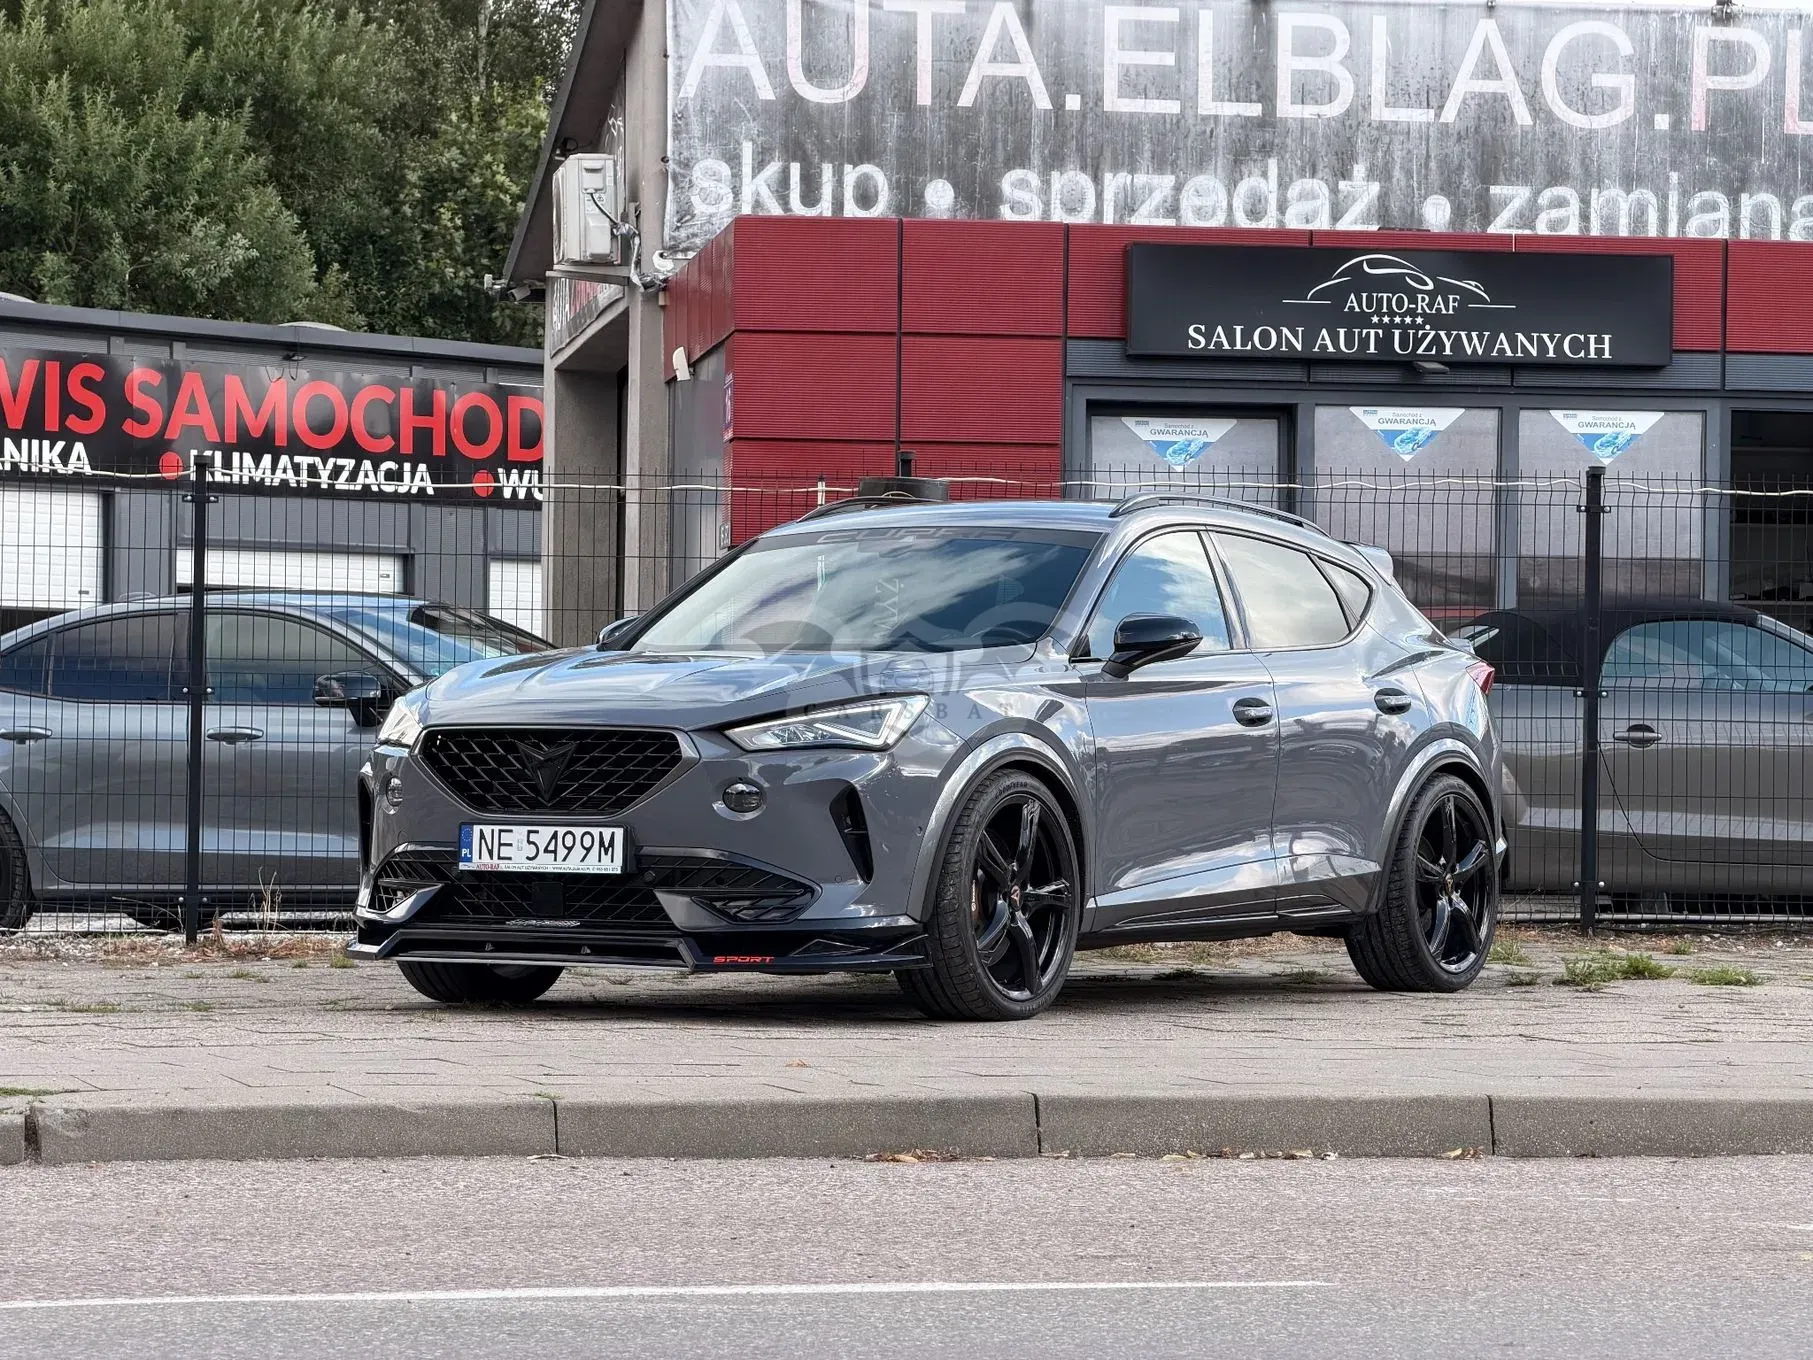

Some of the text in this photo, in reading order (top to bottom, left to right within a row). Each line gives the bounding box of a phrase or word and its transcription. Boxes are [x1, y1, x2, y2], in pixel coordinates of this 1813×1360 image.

[690, 140, 889, 217] skup
[999, 157, 1381, 232] sprzedaż
[1344, 292, 1460, 315] AUTO-RAF
[1187, 324, 1613, 359] SALON AUT UŻYWANYCH
[121, 366, 544, 462] SAMOCHOD
[1377, 417, 1437, 427] GWARANCJĄ
[1577, 421, 1636, 430] GWARANCJĄ
[1150, 427, 1209, 438] GWARANCJĄ
[0, 437, 93, 476] NIKA
[189, 449, 435, 495] KLIMATYZACJA
[461, 848, 472, 858] PL
[478, 828, 616, 864] NE 5499M
